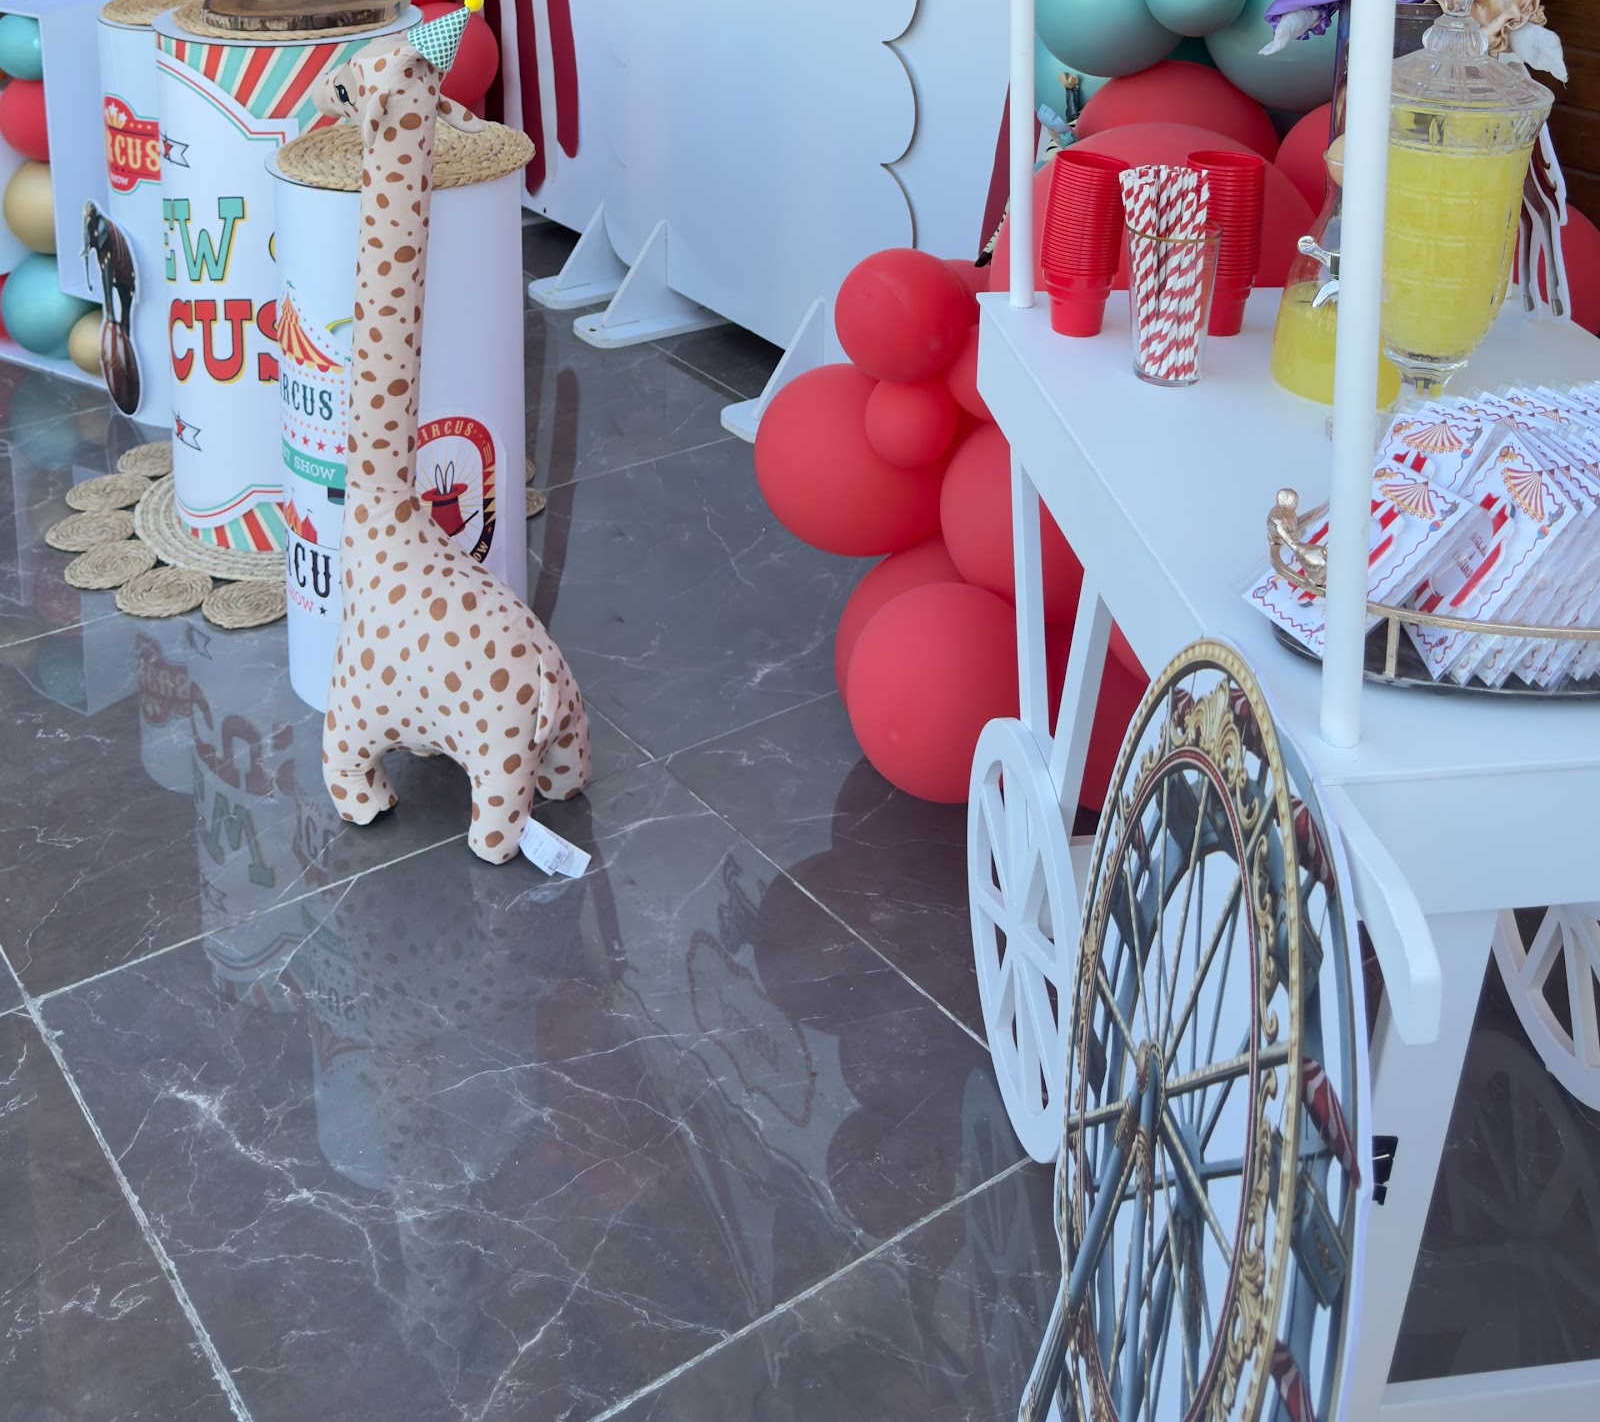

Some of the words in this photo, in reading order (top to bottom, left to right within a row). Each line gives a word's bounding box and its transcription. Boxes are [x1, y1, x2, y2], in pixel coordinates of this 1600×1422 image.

[281, 371, 333, 421] RCUS
[418, 420, 475, 446] IRCUS
[294, 455, 336, 481] SHOW
